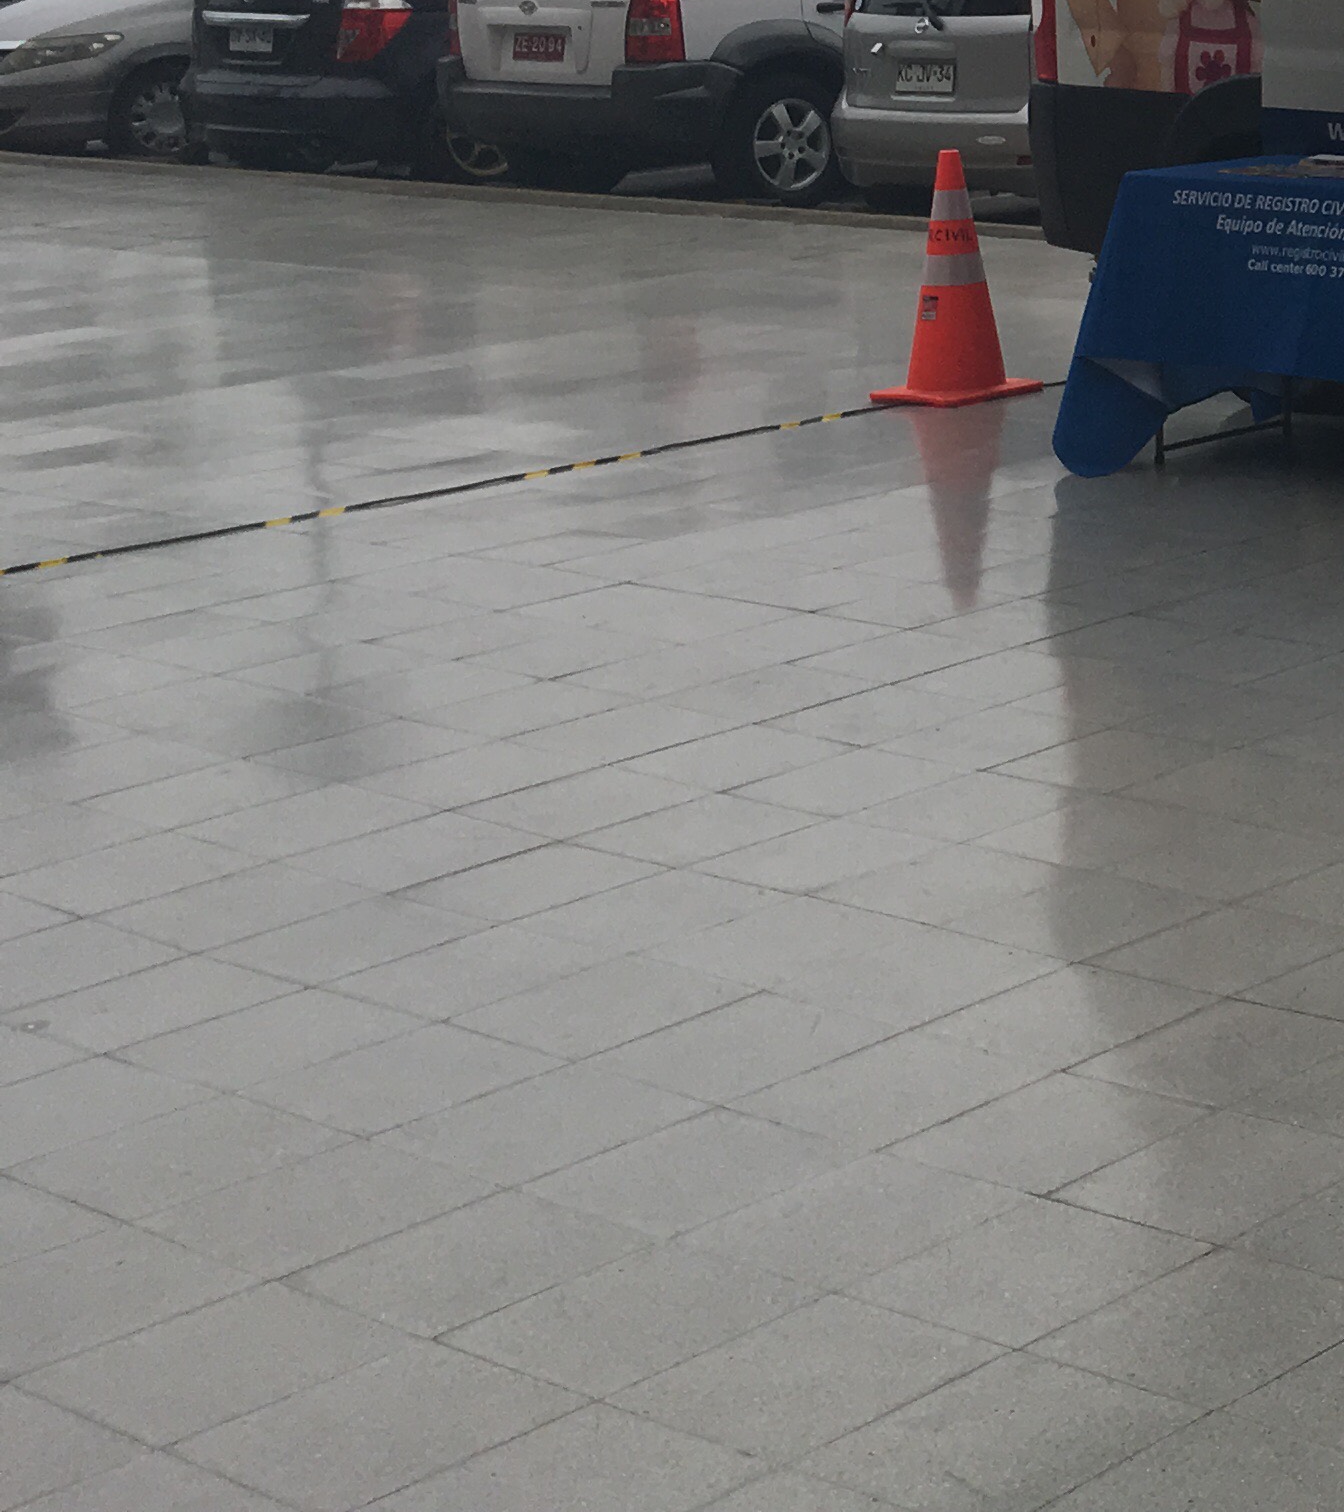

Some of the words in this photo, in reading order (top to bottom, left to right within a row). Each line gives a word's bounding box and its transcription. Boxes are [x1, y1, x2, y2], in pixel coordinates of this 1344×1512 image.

[1172, 190, 1232, 207] SERVICIO
[1234, 193, 1253, 209] DE
[1255, 195, 1319, 214] REGISTRO
[1216, 214, 1263, 235] Equipo
[1266, 216, 1282, 235] de
[1247, 258, 1268, 271] Call
[1270, 262, 1304, 275] center
